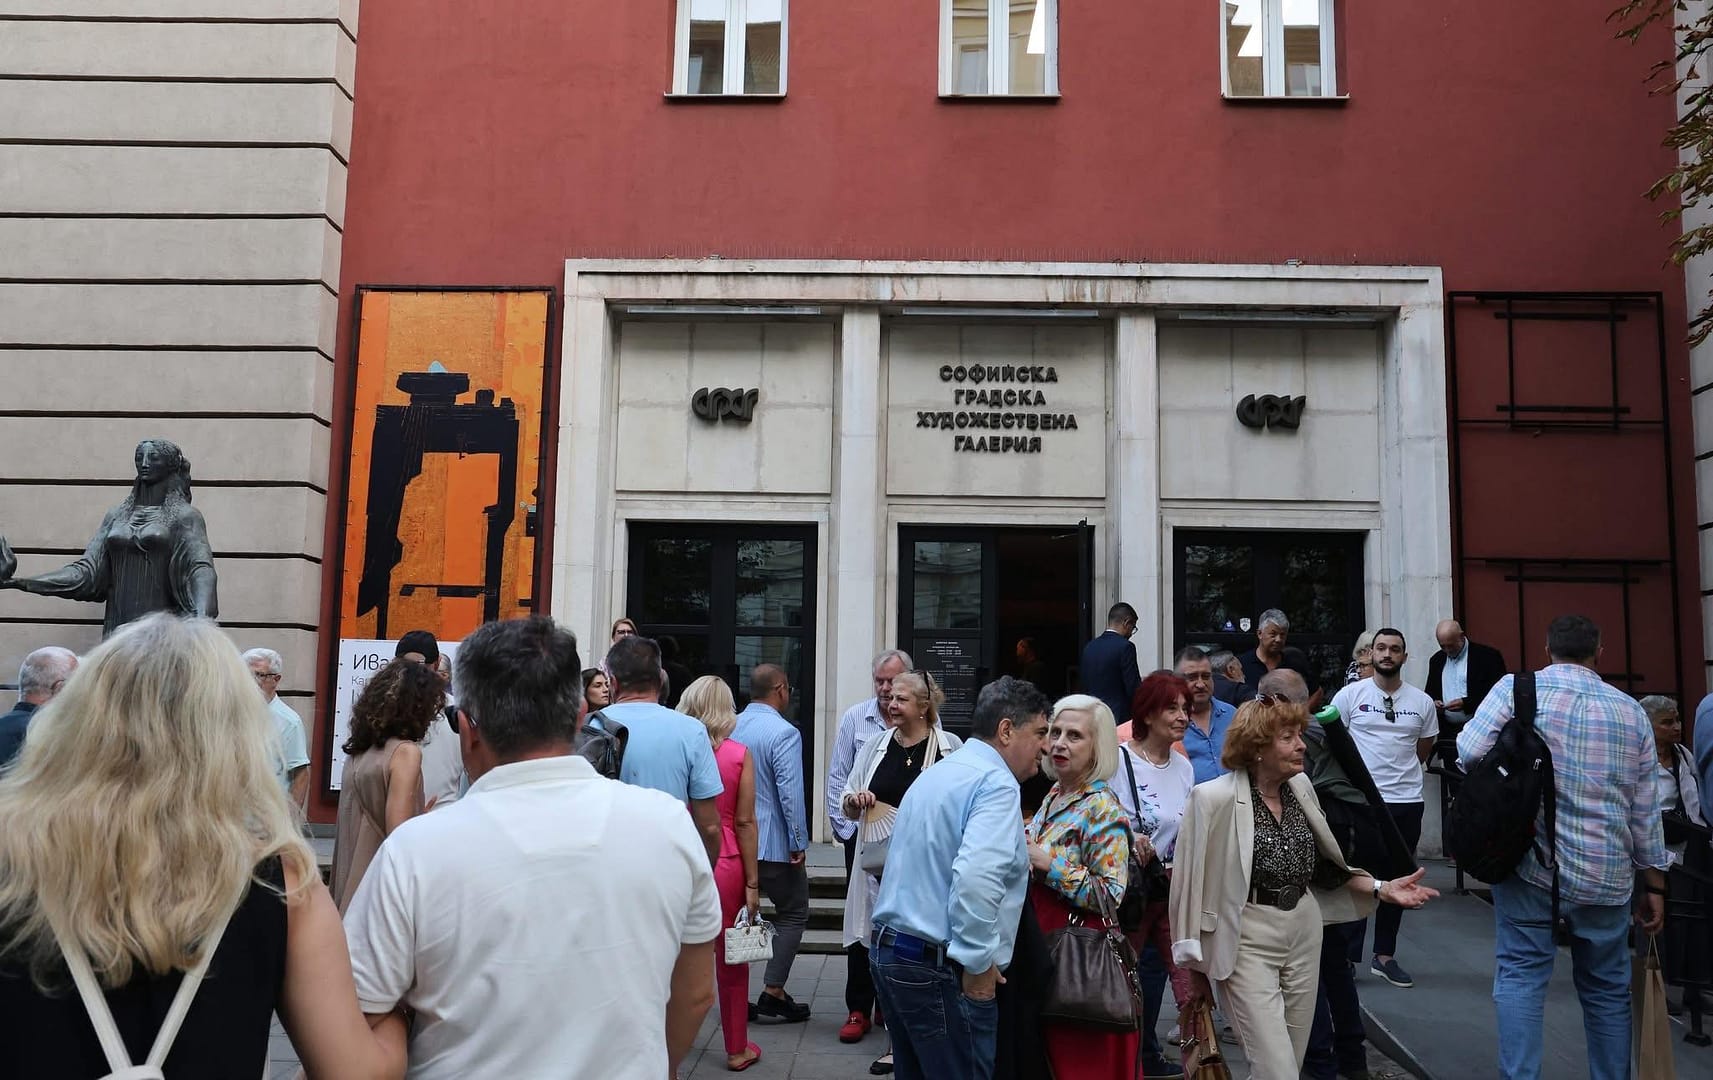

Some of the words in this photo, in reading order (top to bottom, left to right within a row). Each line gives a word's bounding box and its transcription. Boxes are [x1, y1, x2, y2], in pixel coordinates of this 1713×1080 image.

[940, 364, 1058, 384] СОФИЙСКА
[954, 389, 1046, 408] ГРАДСКА
[916, 411, 1078, 431] ХУДОЖЕСТВЕНА
[954, 435, 1042, 453] ГАЛЕРИЯ
[353, 653, 391, 670] Ива
[1359, 704, 1420, 718] Chapion
